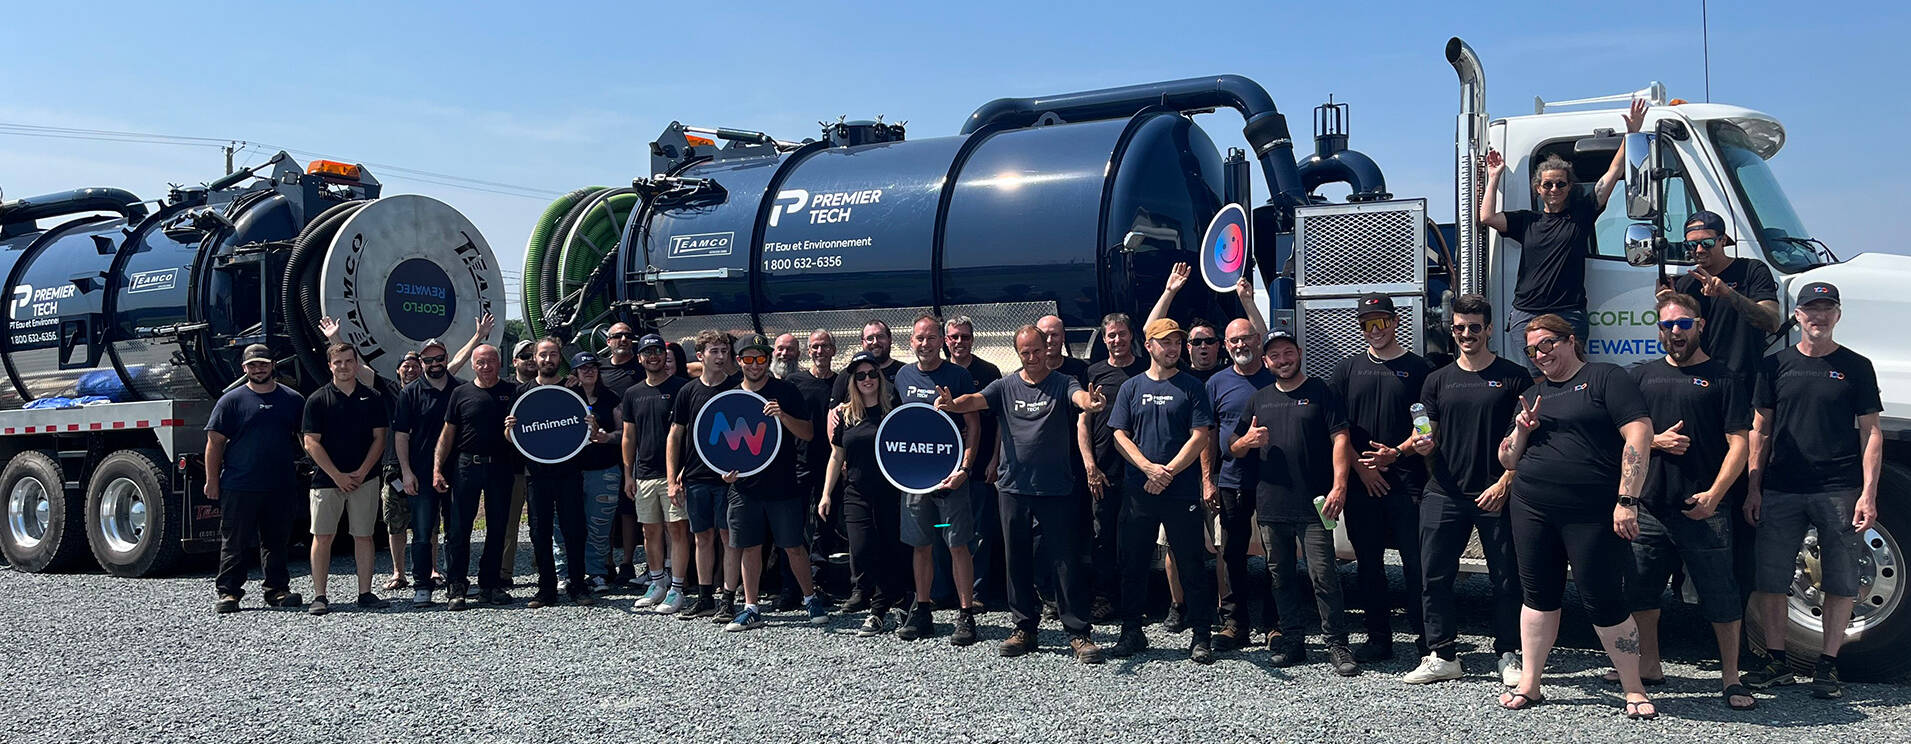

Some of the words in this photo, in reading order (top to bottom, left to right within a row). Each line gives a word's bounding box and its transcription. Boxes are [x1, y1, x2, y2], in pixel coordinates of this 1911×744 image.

[811, 189, 882, 208] PREMIER
[809, 207, 851, 225] TECH
[673, 237, 728, 255] TEAMCO
[764, 242, 776, 252] PT
[775, 242, 792, 252] Eau
[792, 241, 802, 251] et
[803, 236, 873, 250] Environnement
[763, 260, 769, 270] 1
[771, 258, 791, 270] 800
[793, 255, 842, 269] 632-6356
[131, 273, 173, 290] TEAMCO
[33, 284, 76, 302] PREMIER
[395, 283, 447, 299] REWATEC
[32, 301, 58, 317] TECH
[343, 232, 386, 372] TEAMCO
[402, 301, 446, 316] ECOFLO
[32, 317, 60, 328] Environne
[1587, 310, 1660, 327] COFLO
[1583, 339, 1668, 355] EWATEC
[521, 415, 580, 434] Infiniment
[885, 441, 907, 453] WE
[908, 442, 934, 454] ARE
[936, 443, 953, 455] PT
